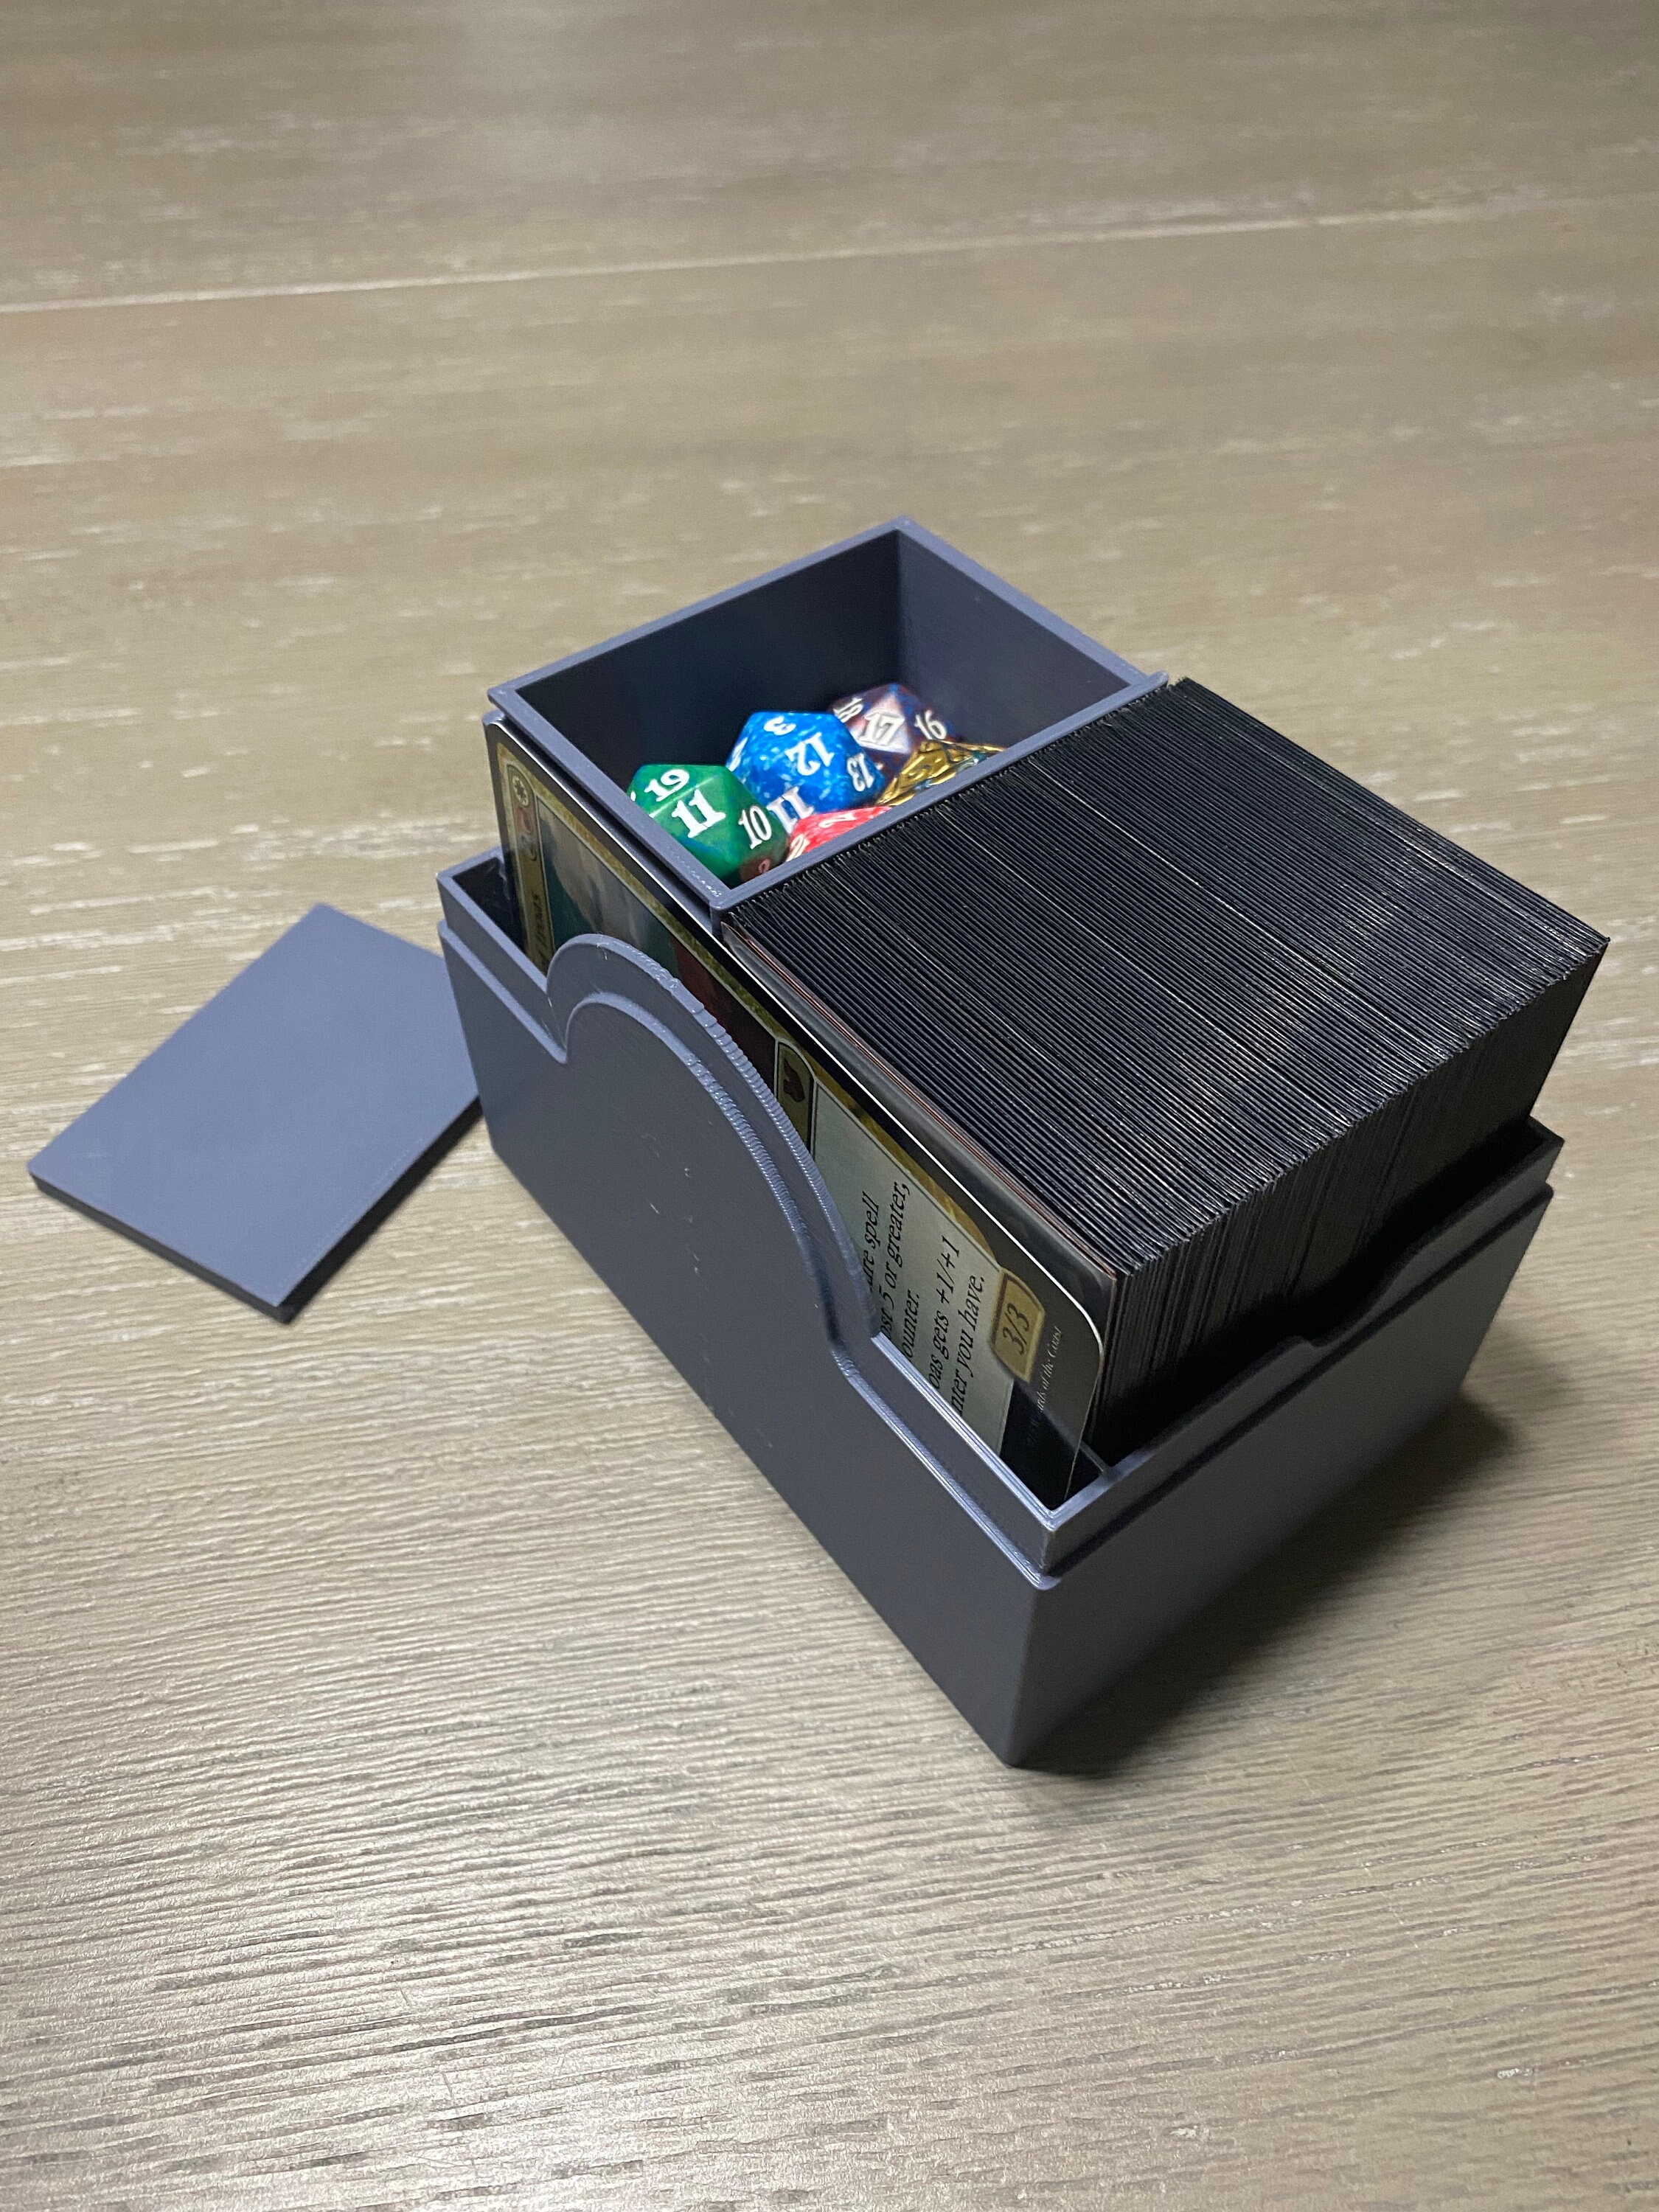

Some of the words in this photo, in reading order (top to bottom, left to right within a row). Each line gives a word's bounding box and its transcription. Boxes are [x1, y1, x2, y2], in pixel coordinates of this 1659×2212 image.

[864, 710, 905, 746] 17
[914, 710, 947, 740] 16
[785, 732, 834, 776] 12
[846, 753, 874, 792] 13
[644, 769, 689, 801] 19
[672, 789, 726, 838] 11
[739, 806, 771, 849] 10
[862, 1191, 880, 1250] spell
[887, 1181, 911, 1268] greater,
[885, 1262, 897, 1289] or
[936, 1235, 960, 1305] +1/+1
[879, 1284, 894, 1310] 5
[958, 1275, 985, 1332] have.
[902, 1290, 920, 1360] ounter.
[933, 1310, 949, 1360] gets
[1003, 1303, 1029, 1356] 3/3
[928, 1354, 944, 1389] oas
[957, 1329, 974, 1378] you
[950, 1368, 967, 1416] nter
